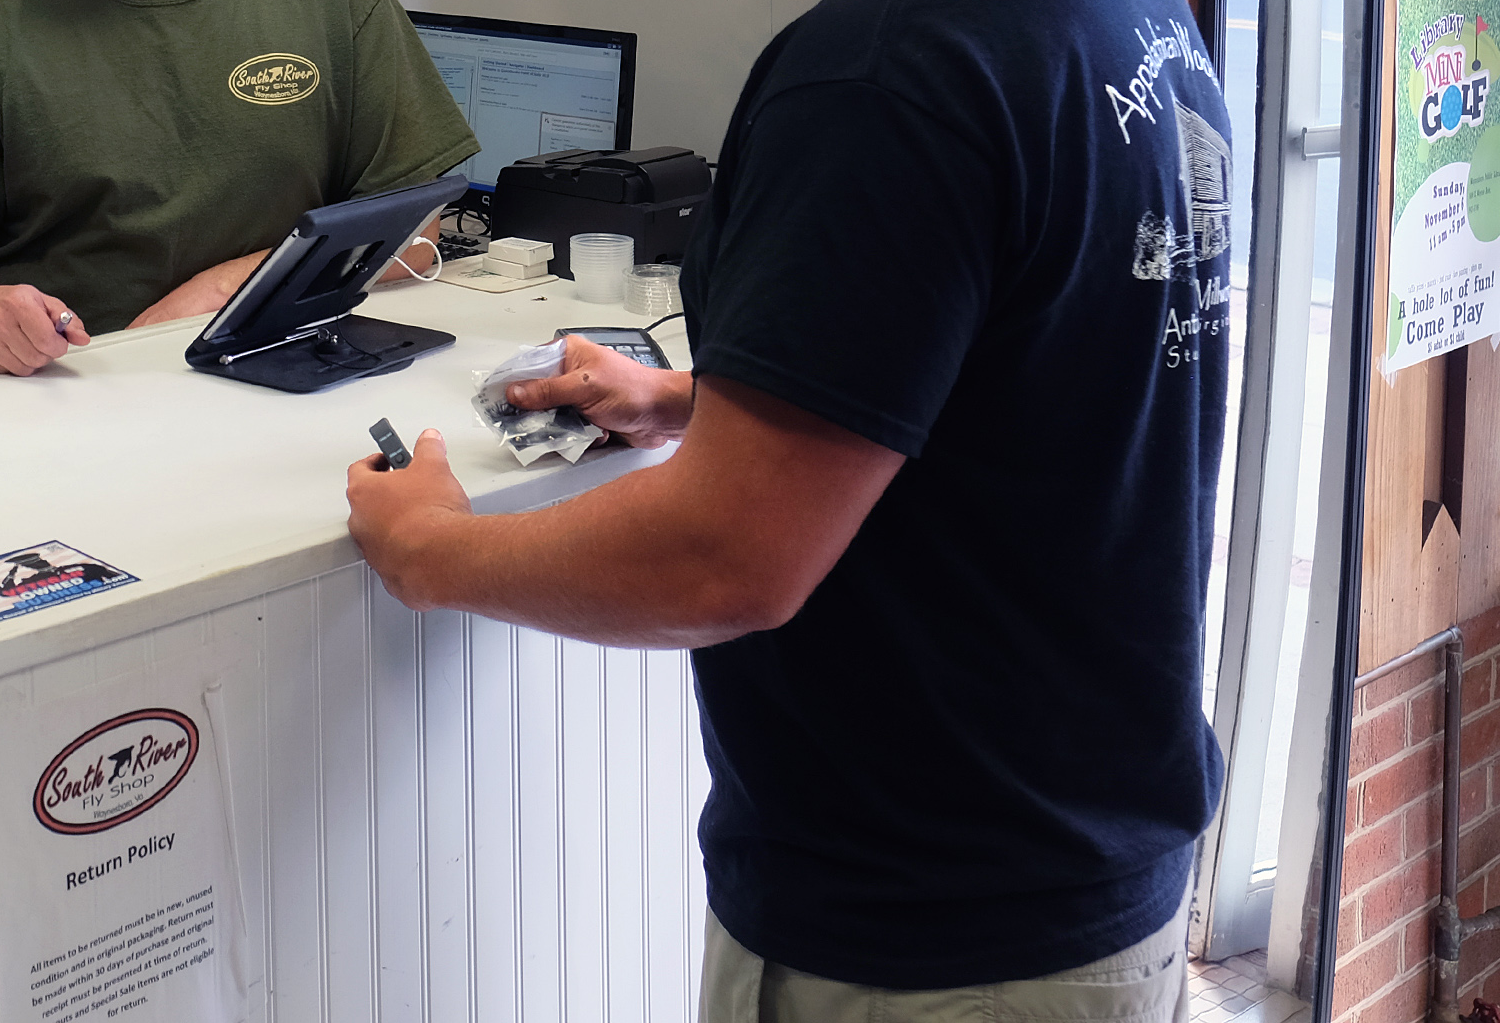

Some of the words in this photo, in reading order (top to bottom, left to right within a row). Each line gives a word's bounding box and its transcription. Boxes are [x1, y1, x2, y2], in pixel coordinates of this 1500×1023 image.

[1410, 12, 1465, 71] Library
[236, 68, 269, 87] South
[284, 64, 313, 81] River
[1421, 76, 1488, 137] GOLF
[1433, 181, 1465, 198] Sunday,
[1425, 203, 1459, 229] November
[1429, 235, 1436, 251] 11
[1438, 230, 1447, 244] am
[1457, 215, 1466, 234] pm
[1398, 300, 1406, 320] A
[1412, 293, 1434, 315] hole
[1440, 286, 1453, 305] lot
[1458, 278, 1469, 298] of
[1474, 270, 1495, 294] fun!
[1407, 317, 1444, 345] Come
[1453, 302, 1484, 328] Play
[2, 570, 85, 596] VETERAN
[14, 579, 103, 610] BUSINESS
[19, 577, 84, 600] OWNED
[47, 755, 105, 808] South
[132, 735, 187, 776] River
[82, 792, 104, 811] Fly
[109, 773, 155, 799] Shop
[66, 854, 122, 891] Return
[128, 833, 176, 864] Policy
[31, 962, 42, 974] All
[43, 954, 66, 969] items
[68, 949, 77, 958] to
[78, 944, 88, 953] be
[90, 925, 123, 948] returned
[125, 917, 144, 932] must
[145, 912, 155, 922] be
[157, 908, 165, 917] in
[166, 900, 184, 913] new,
[186, 885, 213, 904] unused
[31, 968, 69, 991] condition
[71, 959, 86, 973] and
[87, 956, 95, 965] in
[97, 940, 125, 961] original
[127, 924, 167, 948] packaging.
[168, 911, 194, 927] Return
[195, 901, 214, 915] must
[32, 996, 43, 1007] be
[44, 985, 67, 1002] made
[68, 973, 94, 989] within
[95, 966, 105, 977] 30
[107, 959, 124, 972] days
[126, 952, 134, 963] of
[135, 937, 169, 960] purchase
[171, 928, 186, 942] and
[187, 915, 214, 935] original
[42, 999, 68, 1019] receipt
[70, 990, 90, 1005] must
[92, 984, 102, 995] be
[104, 964, 142, 991] presented
[144, 960, 152, 970] at
[153, 953, 172, 966] time
[173, 946, 181, 957] of
[182, 937, 208, 953] return.
[75, 1005, 90, 1018] and
[91, 991, 118, 1011] Special
[119, 984, 136, 997] Sale
[137, 974, 160, 989] items
[161, 968, 174, 979] are
[175, 960, 188, 972] not
[190, 947, 214, 965] eligible
[107, 1008, 119, 1018] for
[121, 996, 148, 1012] return.
